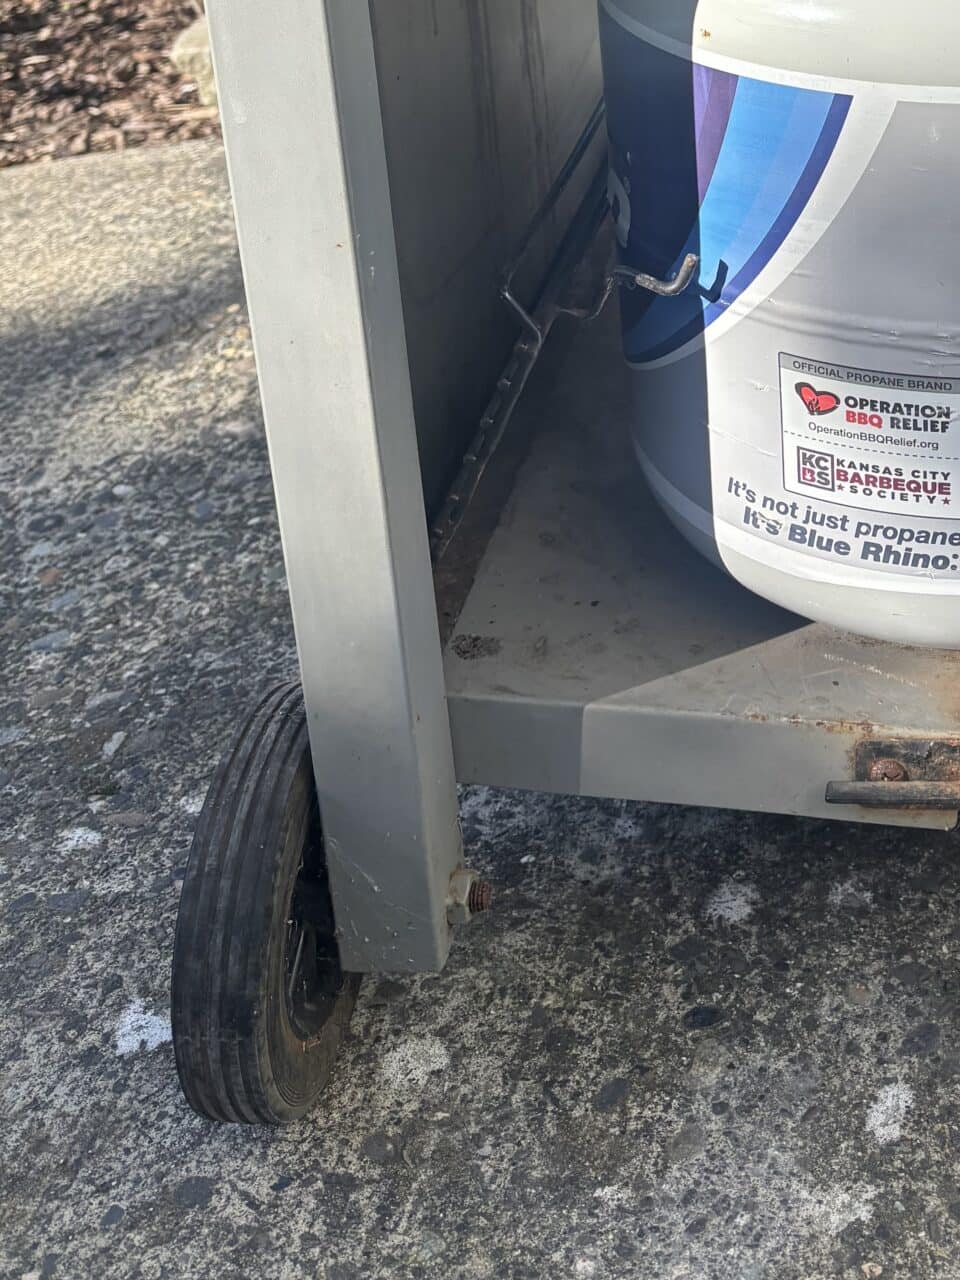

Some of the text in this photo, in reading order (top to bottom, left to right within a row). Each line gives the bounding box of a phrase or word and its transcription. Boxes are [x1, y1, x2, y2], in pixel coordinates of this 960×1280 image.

[793, 360, 952, 390] OFFICIAL PROPANE BRAND
[845, 396, 950, 419] OPERATION
[845, 410, 949, 433] BBQ RELIEF
[809, 421, 939, 450] OperationBBQRelief.org
[836, 469, 951, 495] BARBEQUE
[837, 458, 951, 481] KANSAS CITY
[728, 476, 756, 503] It's
[762, 496, 798, 519] not
[803, 506, 849, 531] just
[850, 485, 936, 504] SOCIETY
[788, 524, 850, 556] Blue
